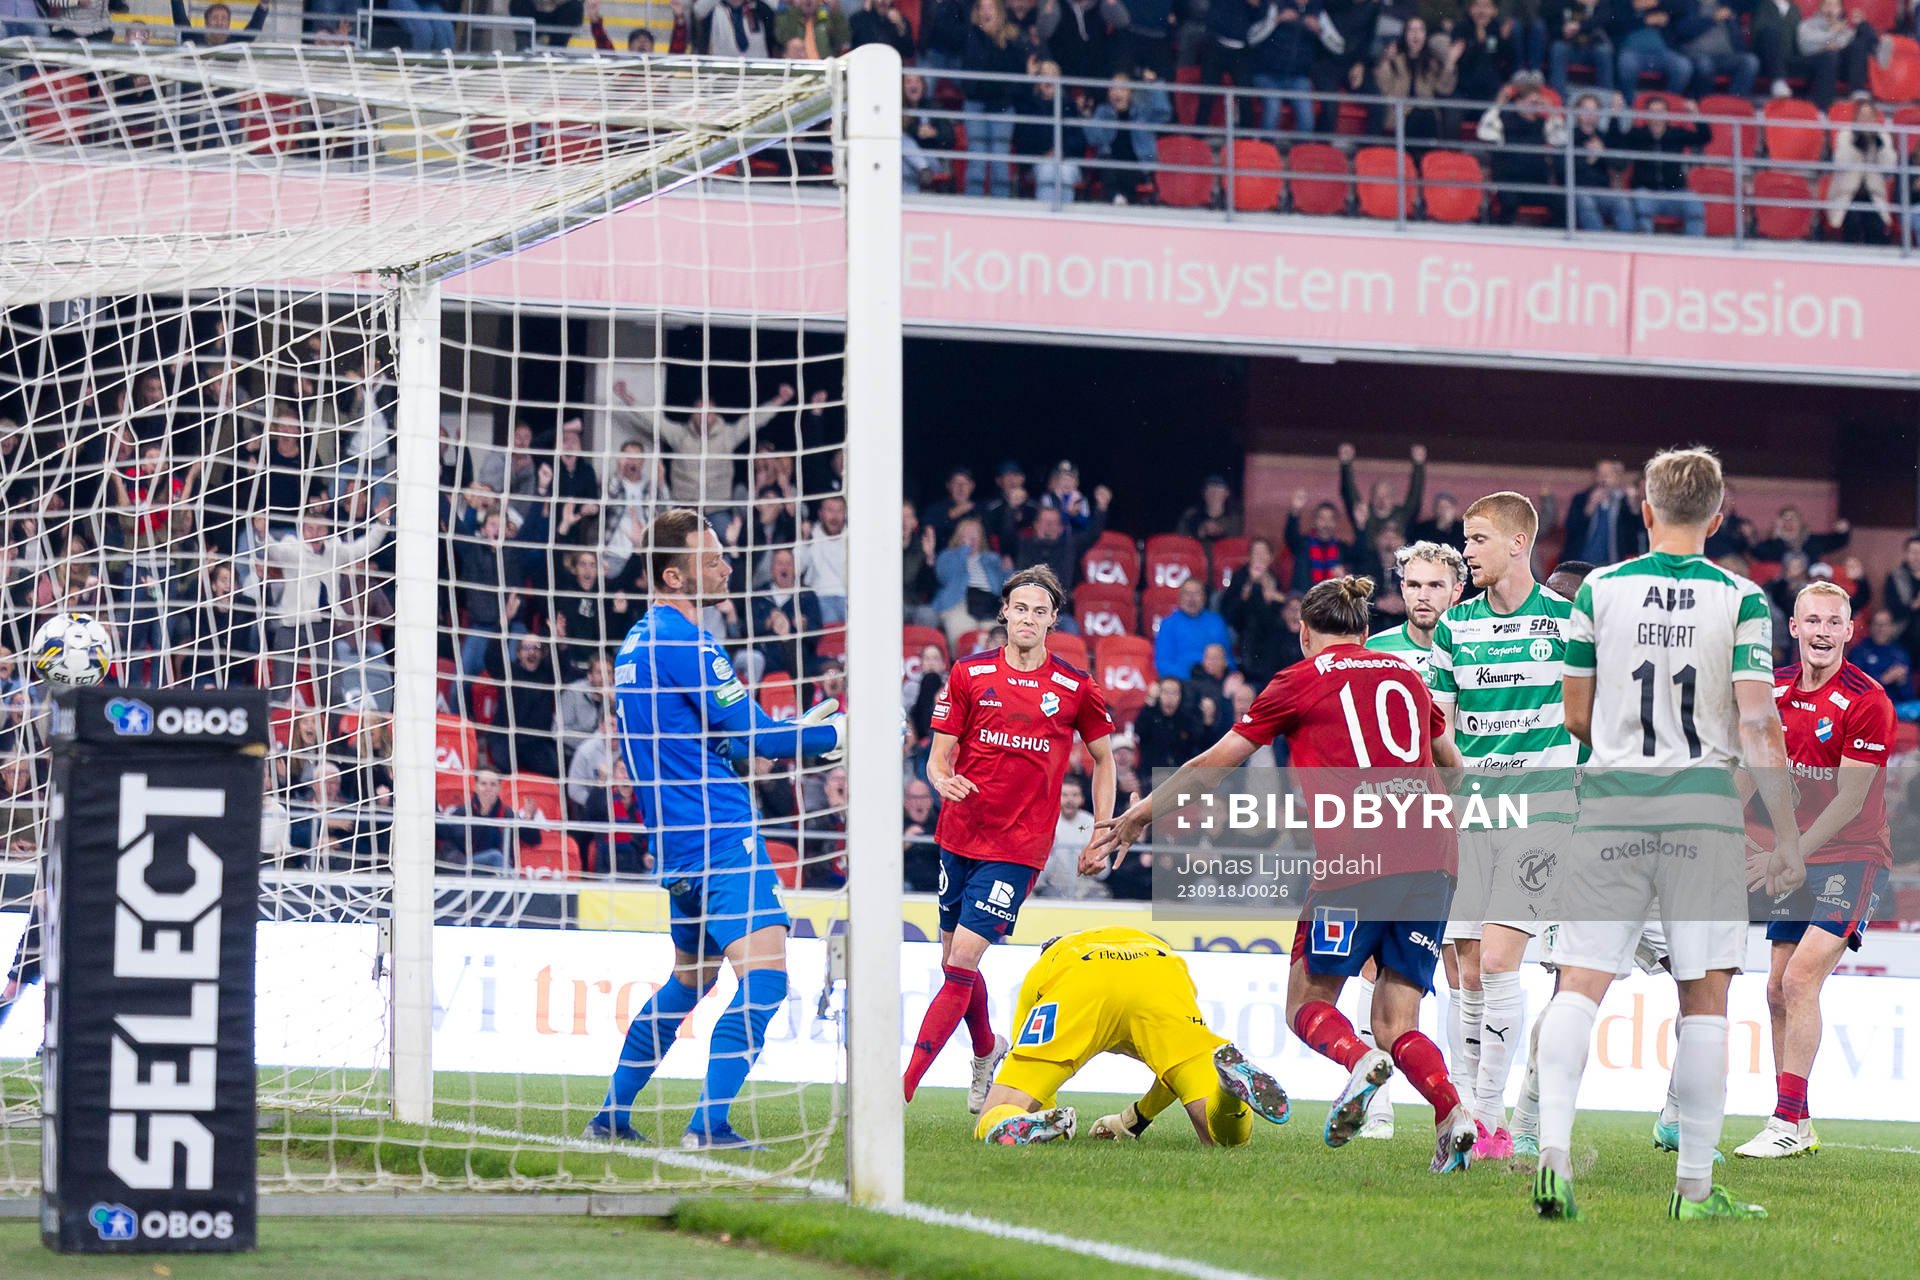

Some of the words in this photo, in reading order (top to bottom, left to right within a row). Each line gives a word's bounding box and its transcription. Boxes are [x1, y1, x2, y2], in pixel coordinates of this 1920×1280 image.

[902, 229, 1396, 319] Ekonomisystem
[1417, 255, 1509, 321] för
[1525, 263, 1618, 327] din
[1635, 280, 1863, 341] passion
[1087, 560, 1129, 586] ICA
[1643, 586, 1697, 612] ABB
[1084, 611, 1126, 636] ICA
[1105, 665, 1147, 691] ICA
[157, 706, 249, 735] OBOS
[1631, 659, 1702, 759] 11
[1339, 679, 1422, 769] 10
[979, 728, 1050, 753] EMILSHUS
[109, 772, 226, 1191] SELECT
[1832, 1004, 1905, 1080] vi
[142, 1211, 234, 1240] OBOS
